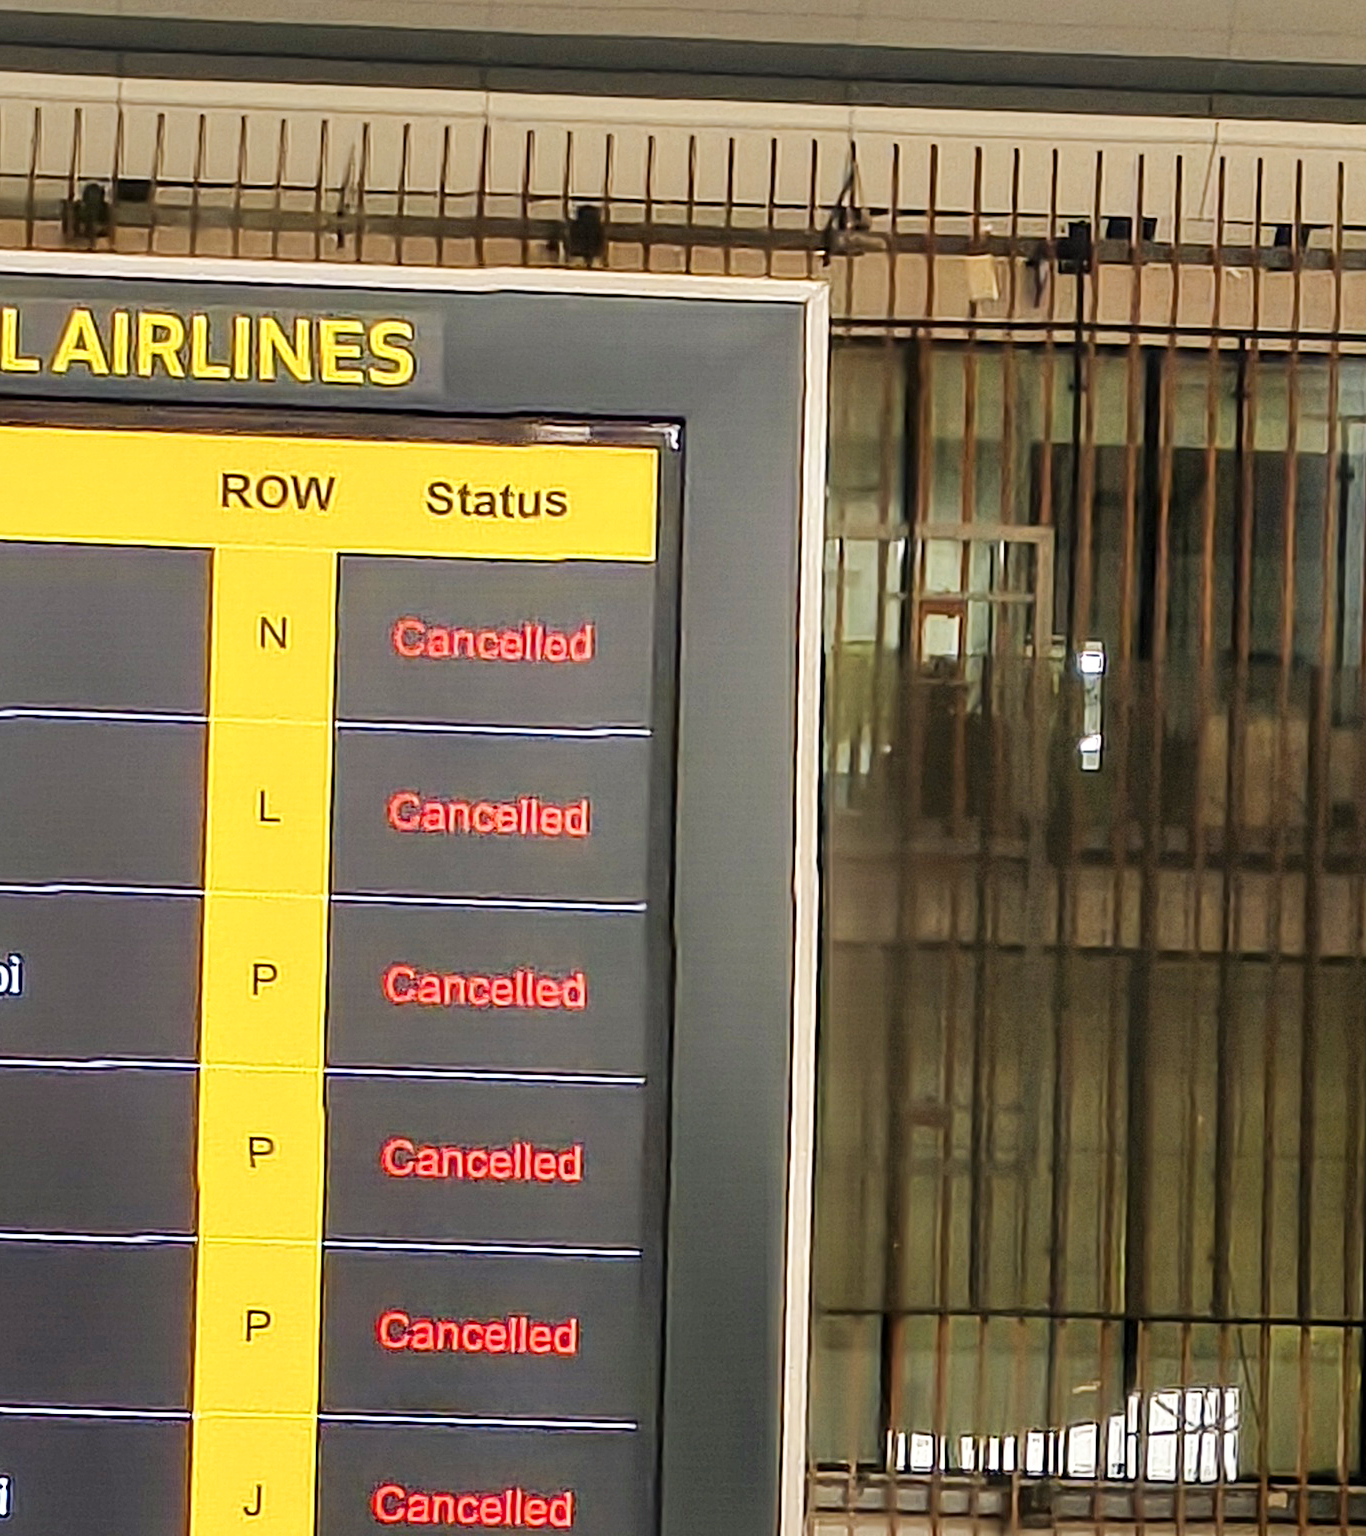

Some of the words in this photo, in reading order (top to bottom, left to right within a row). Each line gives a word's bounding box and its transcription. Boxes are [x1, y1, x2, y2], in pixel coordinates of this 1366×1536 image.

[51, 308, 416, 387] AIRLINES
[221, 472, 336, 512] ROW
[426, 481, 568, 519] Status
[260, 616, 287, 649] N
[390, 617, 596, 665] Cancelled
[260, 790, 281, 823] L
[385, 789, 591, 839] Cancelled
[252, 963, 278, 996] P
[381, 963, 588, 1011] Cancelled
[248, 1136, 274, 1169] P
[379, 1135, 584, 1185] Cancelled
[245, 1309, 271, 1343] P
[374, 1309, 580, 1357] Cancelled
[243, 1484, 262, 1517] J
[370, 1482, 575, 1529] Cancelled
